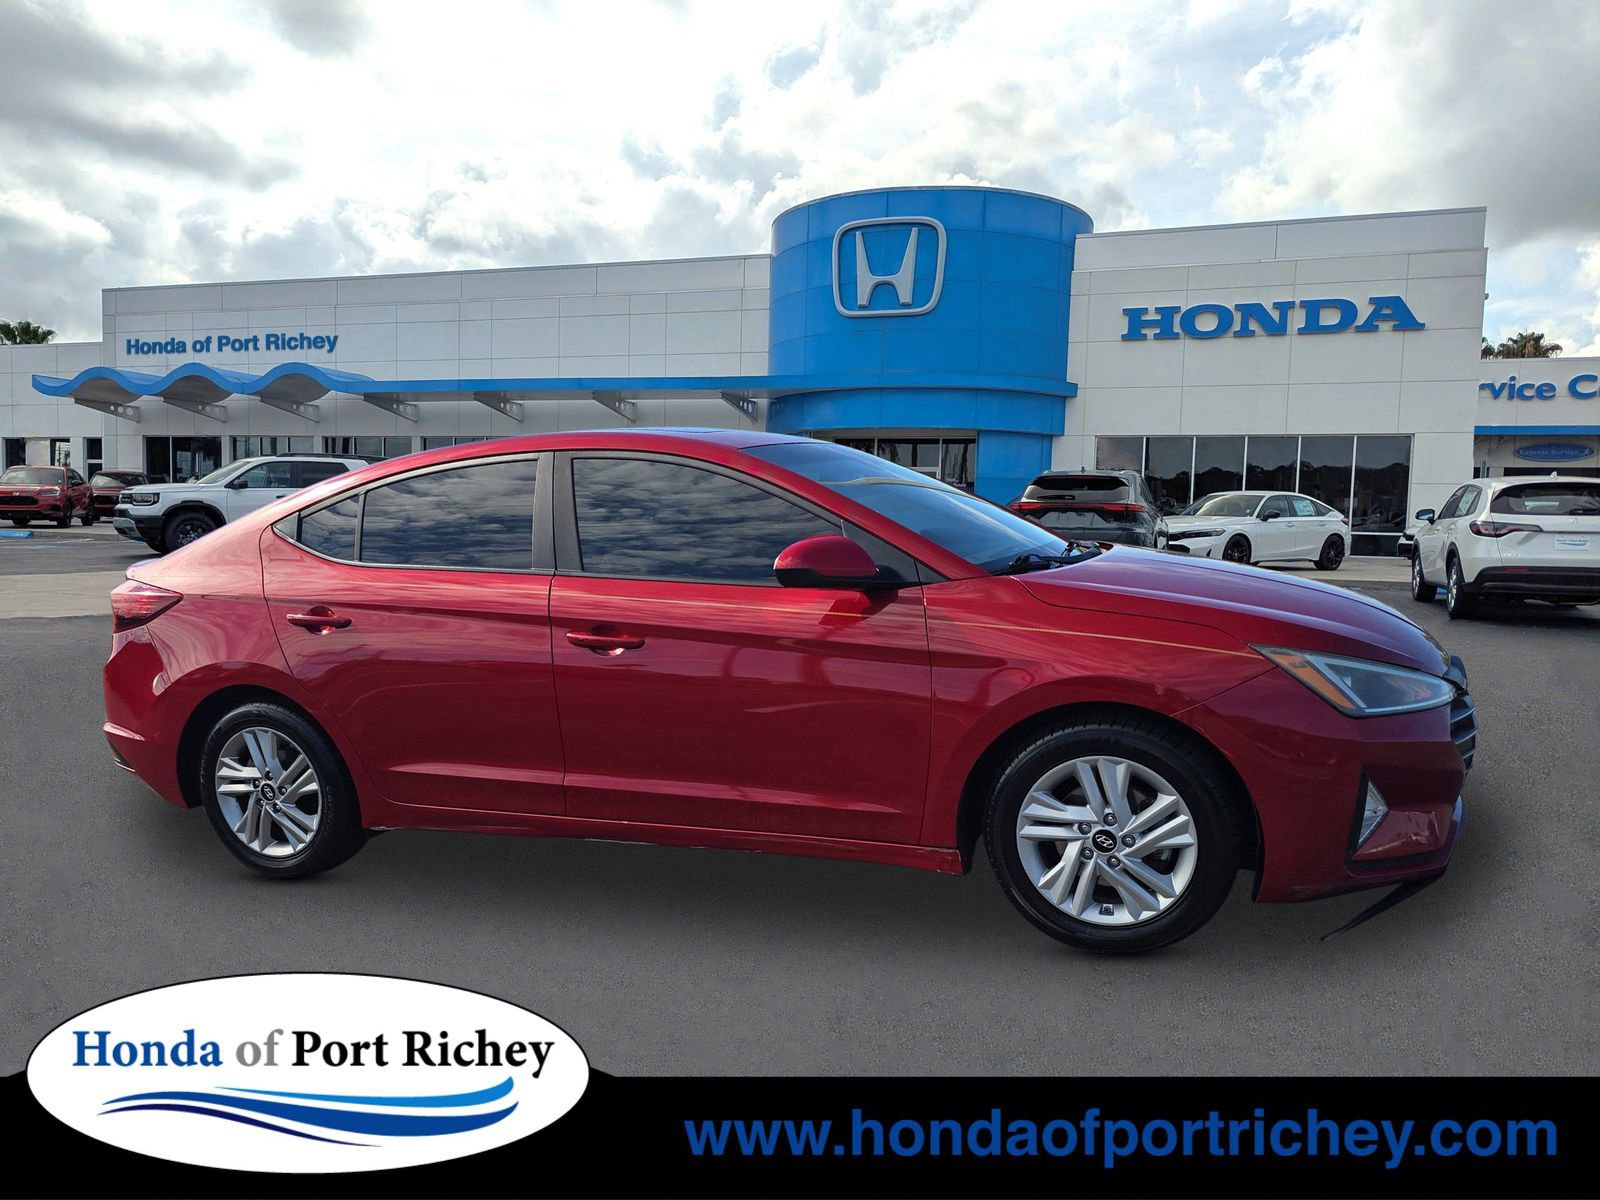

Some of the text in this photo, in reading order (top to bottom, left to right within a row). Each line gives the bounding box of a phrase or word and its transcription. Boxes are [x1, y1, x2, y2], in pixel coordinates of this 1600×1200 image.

[1121, 296, 1424, 340] HONDA
[126, 332, 338, 355] Honda of Port Richey
[1568, 374, 1600, 400] C
